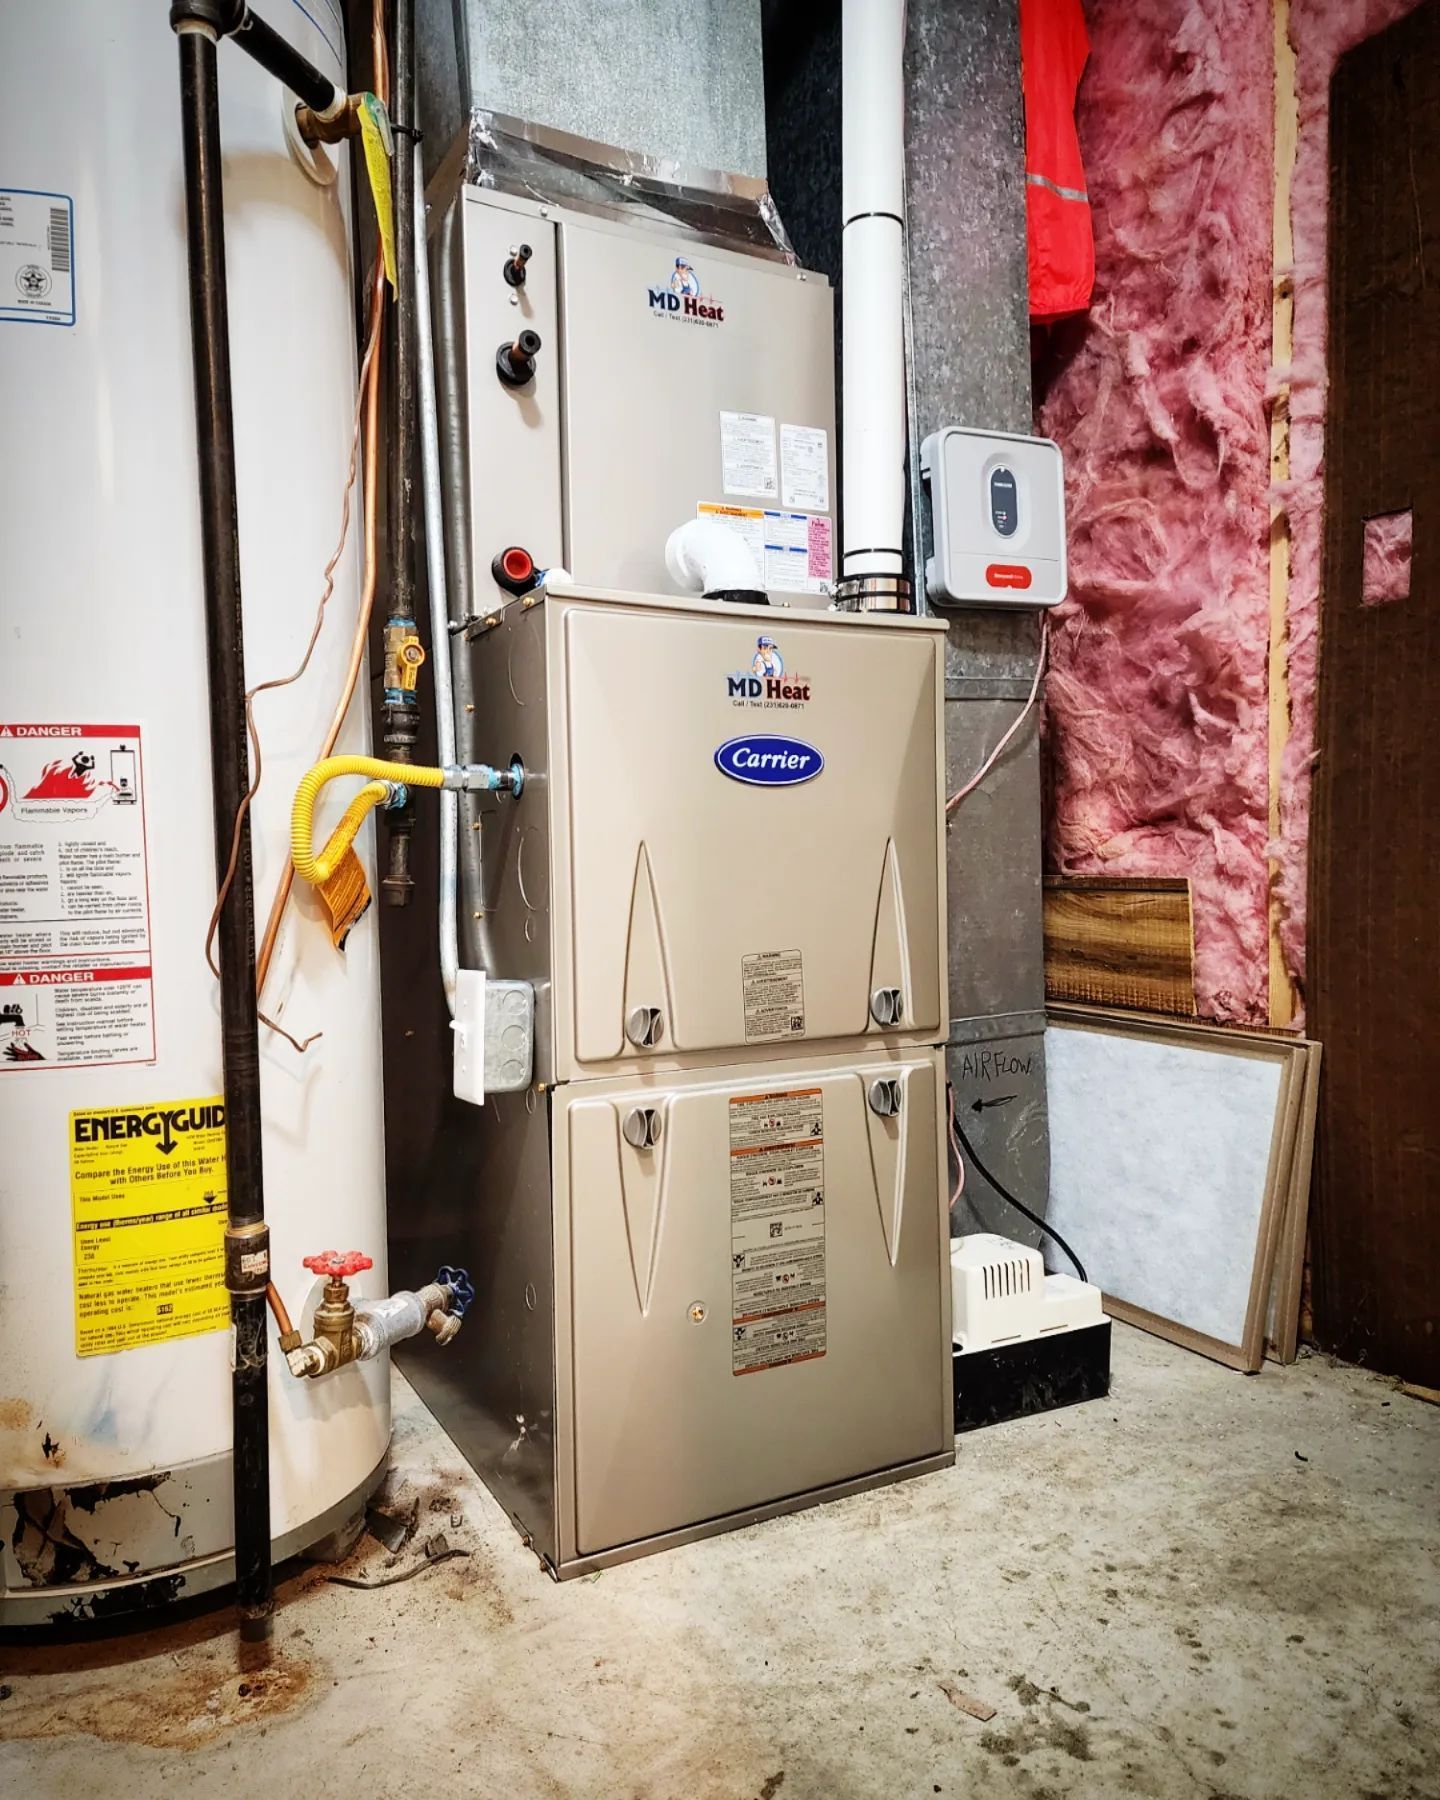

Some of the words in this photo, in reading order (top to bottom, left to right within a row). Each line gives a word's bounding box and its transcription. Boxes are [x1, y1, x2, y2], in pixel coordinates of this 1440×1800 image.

[648, 289, 680, 311] MD
[684, 297, 724, 321] Heat
[727, 677, 762, 697] MD
[767, 679, 810, 700] Heat
[16, 726, 82, 736] DANGER
[732, 747, 810, 769] Carrier
[29, 972, 94, 983] DANGER
[963, 1051, 1032, 1082] AIRFLOW
[75, 1105, 225, 1143] ENERGYGUID
[75, 1169, 110, 1180] Compare
[113, 1166, 125, 1176] the
[128, 1166, 154, 1174] Energy
[156, 1162, 170, 1170] Use
[173, 1160, 180, 1169] of
[182, 1158, 196, 1167] this
[198, 1156, 219, 1165] Water
[110, 1175, 127, 1185] with
[129, 1172, 154, 1183] Others
[157, 1170, 181, 1180] Before
[212, 1203, 228, 1212] mode
[79, 1290, 104, 1300] Natural
